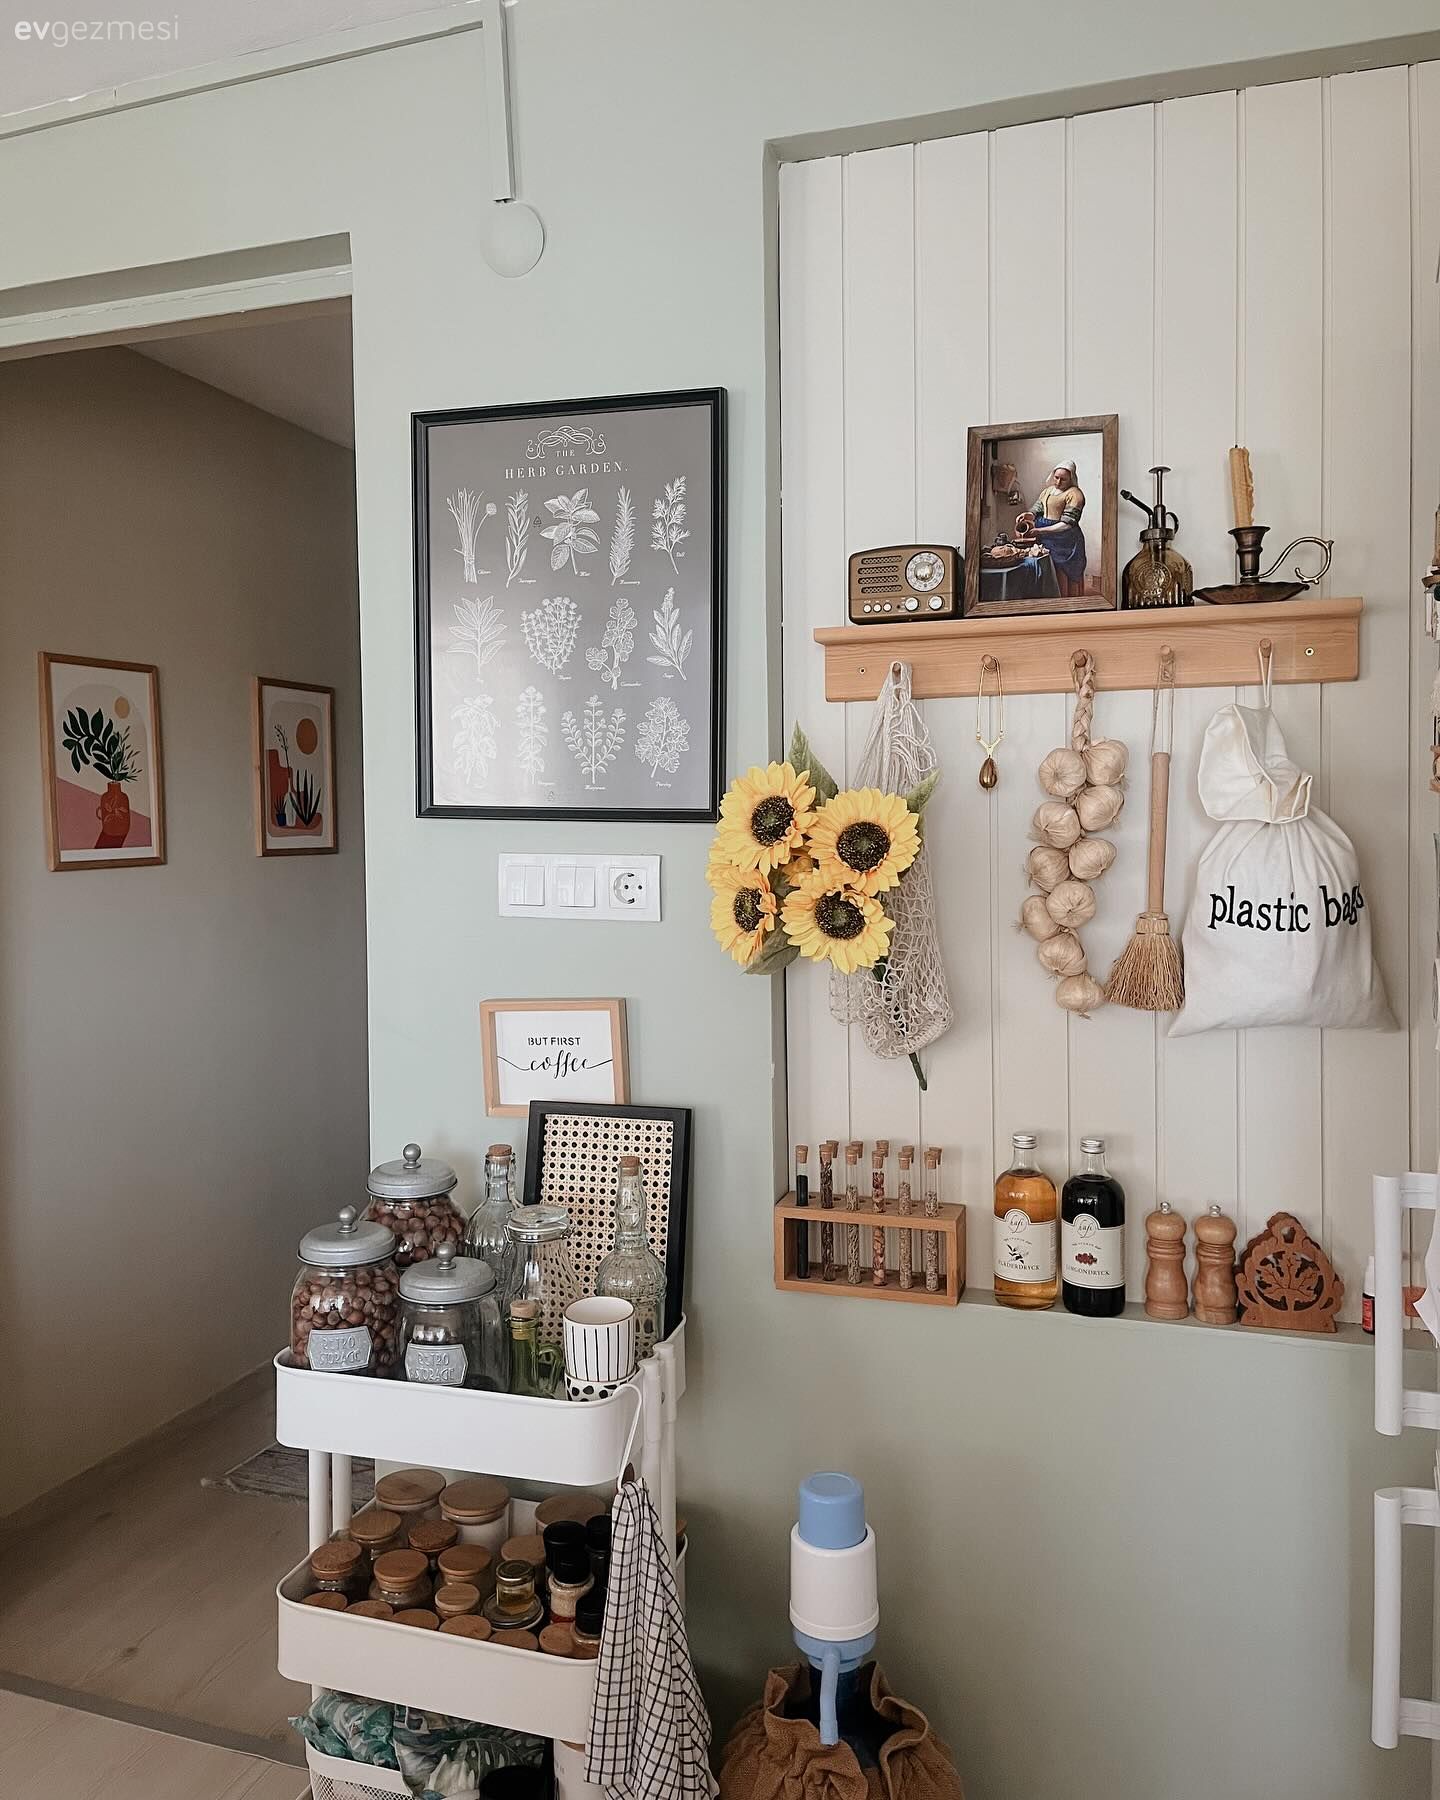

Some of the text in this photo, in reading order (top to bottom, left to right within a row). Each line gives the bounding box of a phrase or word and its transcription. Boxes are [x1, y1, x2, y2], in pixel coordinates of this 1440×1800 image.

[555, 449, 576, 458] THE
[504, 465, 547, 479] HERB
[1207, 885, 1311, 933] plastic
[528, 1037, 581, 1046] BUT FIRST
[525, 1049, 594, 1079] coffee
